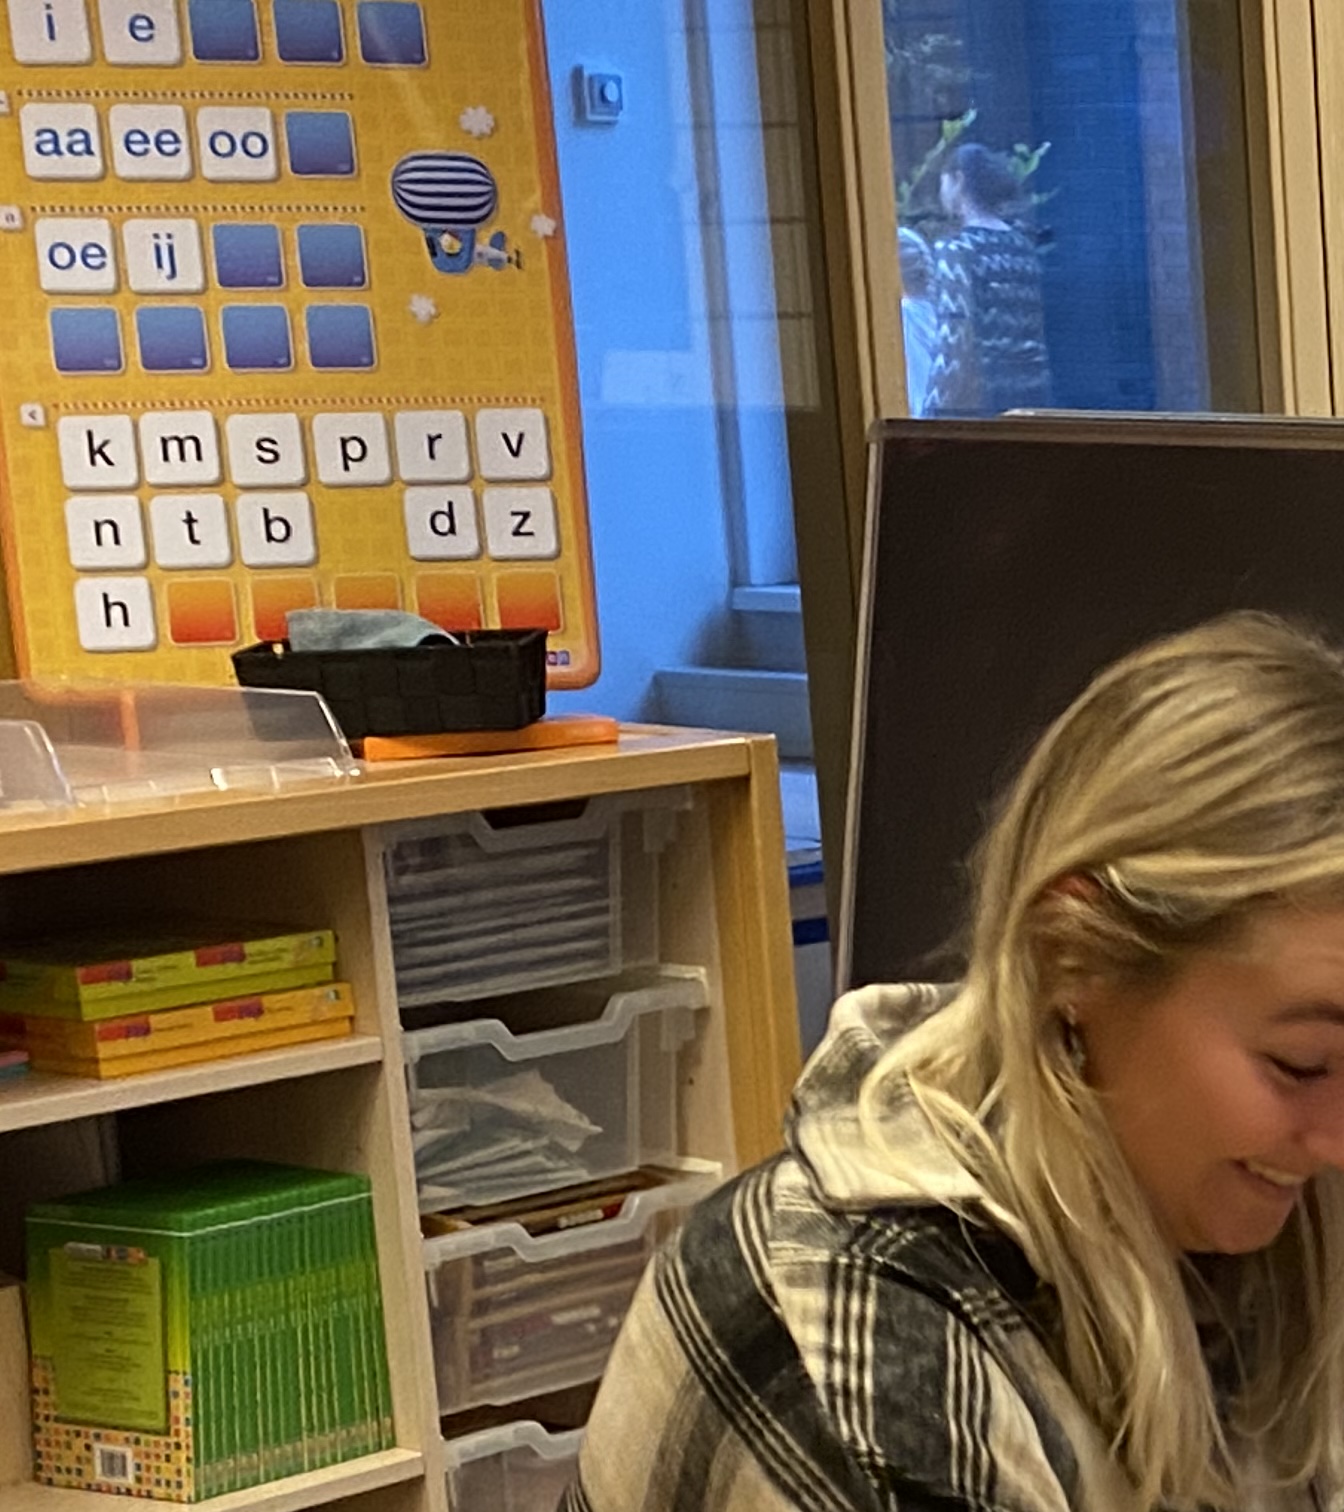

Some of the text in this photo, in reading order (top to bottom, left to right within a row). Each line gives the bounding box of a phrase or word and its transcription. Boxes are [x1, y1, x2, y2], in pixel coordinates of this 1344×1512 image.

[128, 13, 155, 42] e
[35, 128, 269, 158] aa ee oo
[48, 232, 178, 281] oe ij
[86, 428, 525, 473] k m s p r v
[94, 500, 535, 547] n t b d z
[101, 591, 130, 629] h
